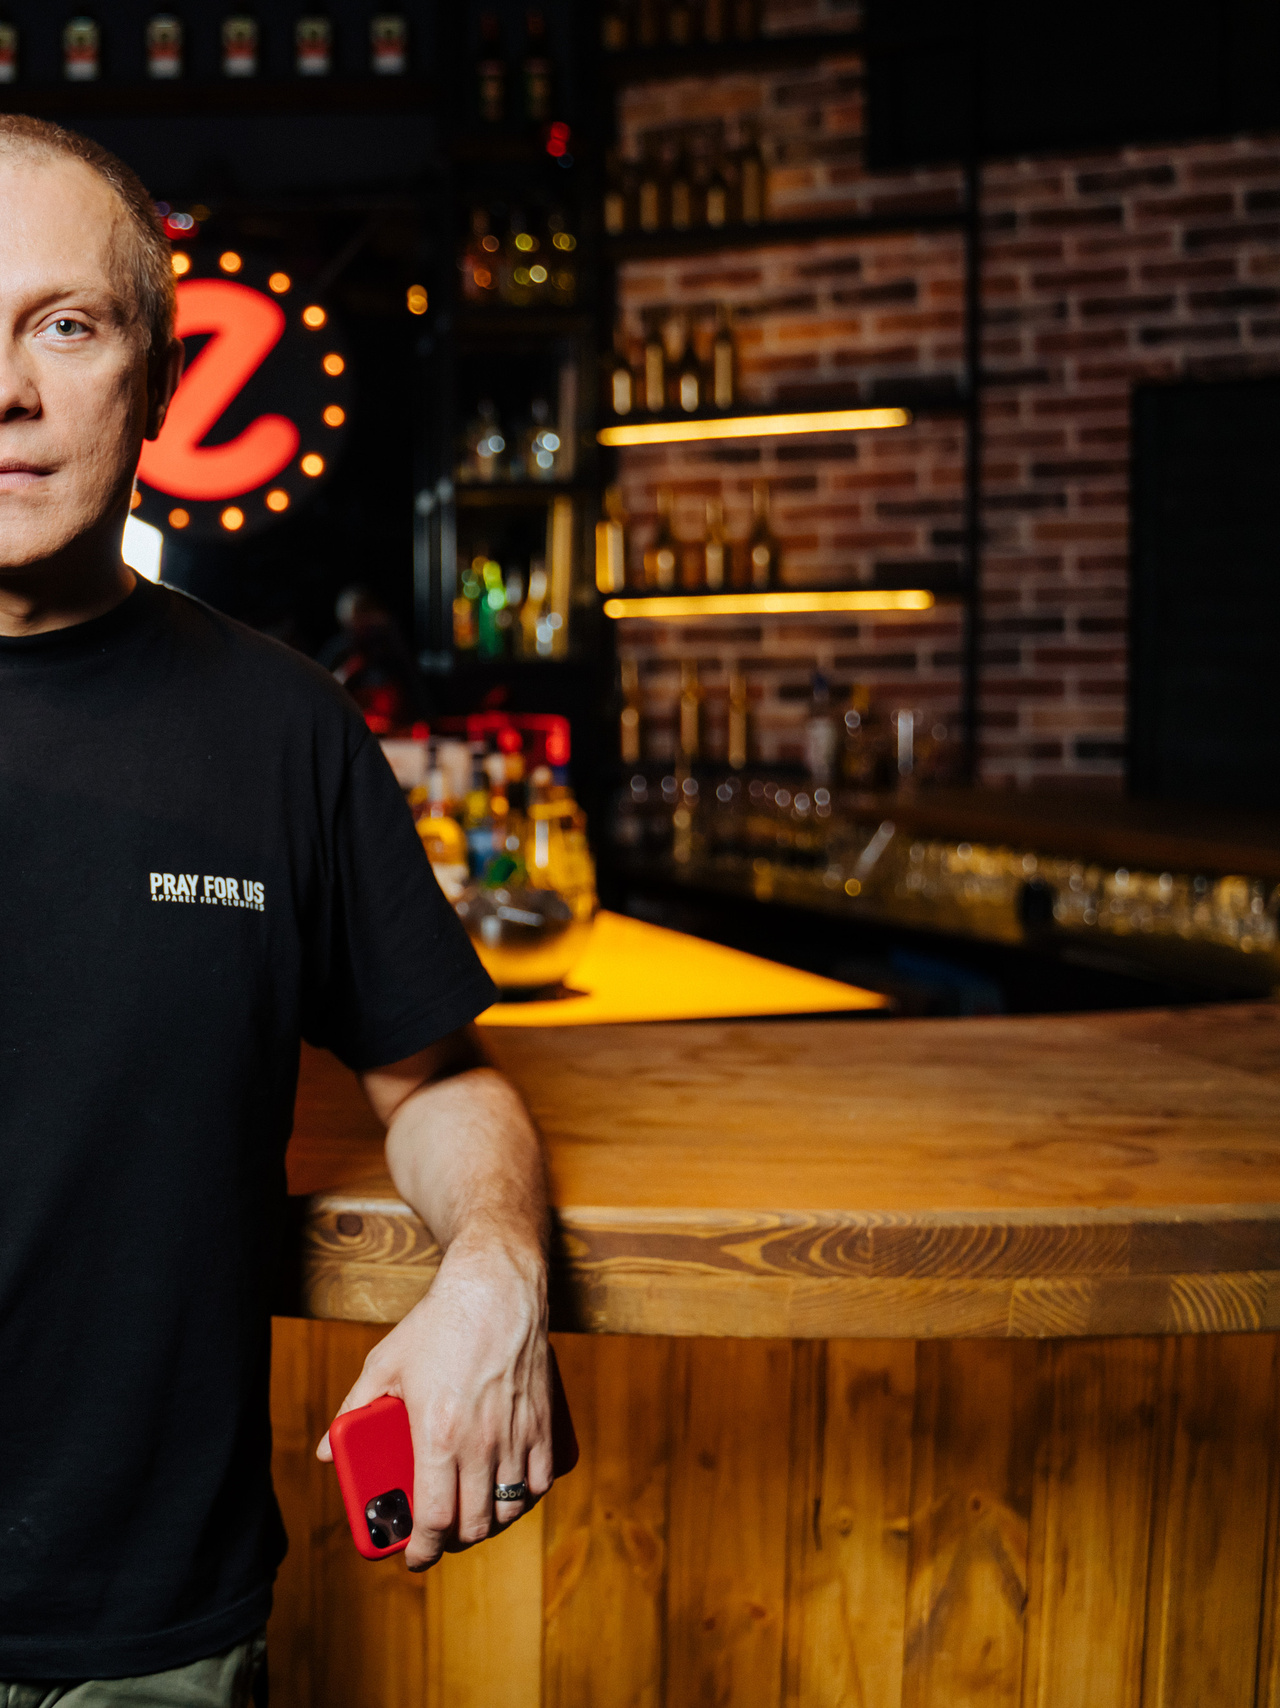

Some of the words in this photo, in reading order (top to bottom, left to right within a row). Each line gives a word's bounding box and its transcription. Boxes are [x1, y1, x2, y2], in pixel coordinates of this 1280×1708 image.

[149, 872, 199, 896] PRAY
[203, 875, 240, 900] FOR
[242, 879, 265, 904] US
[151, 894, 196, 903] APPAREL
[200, 896, 218, 905] FOR
